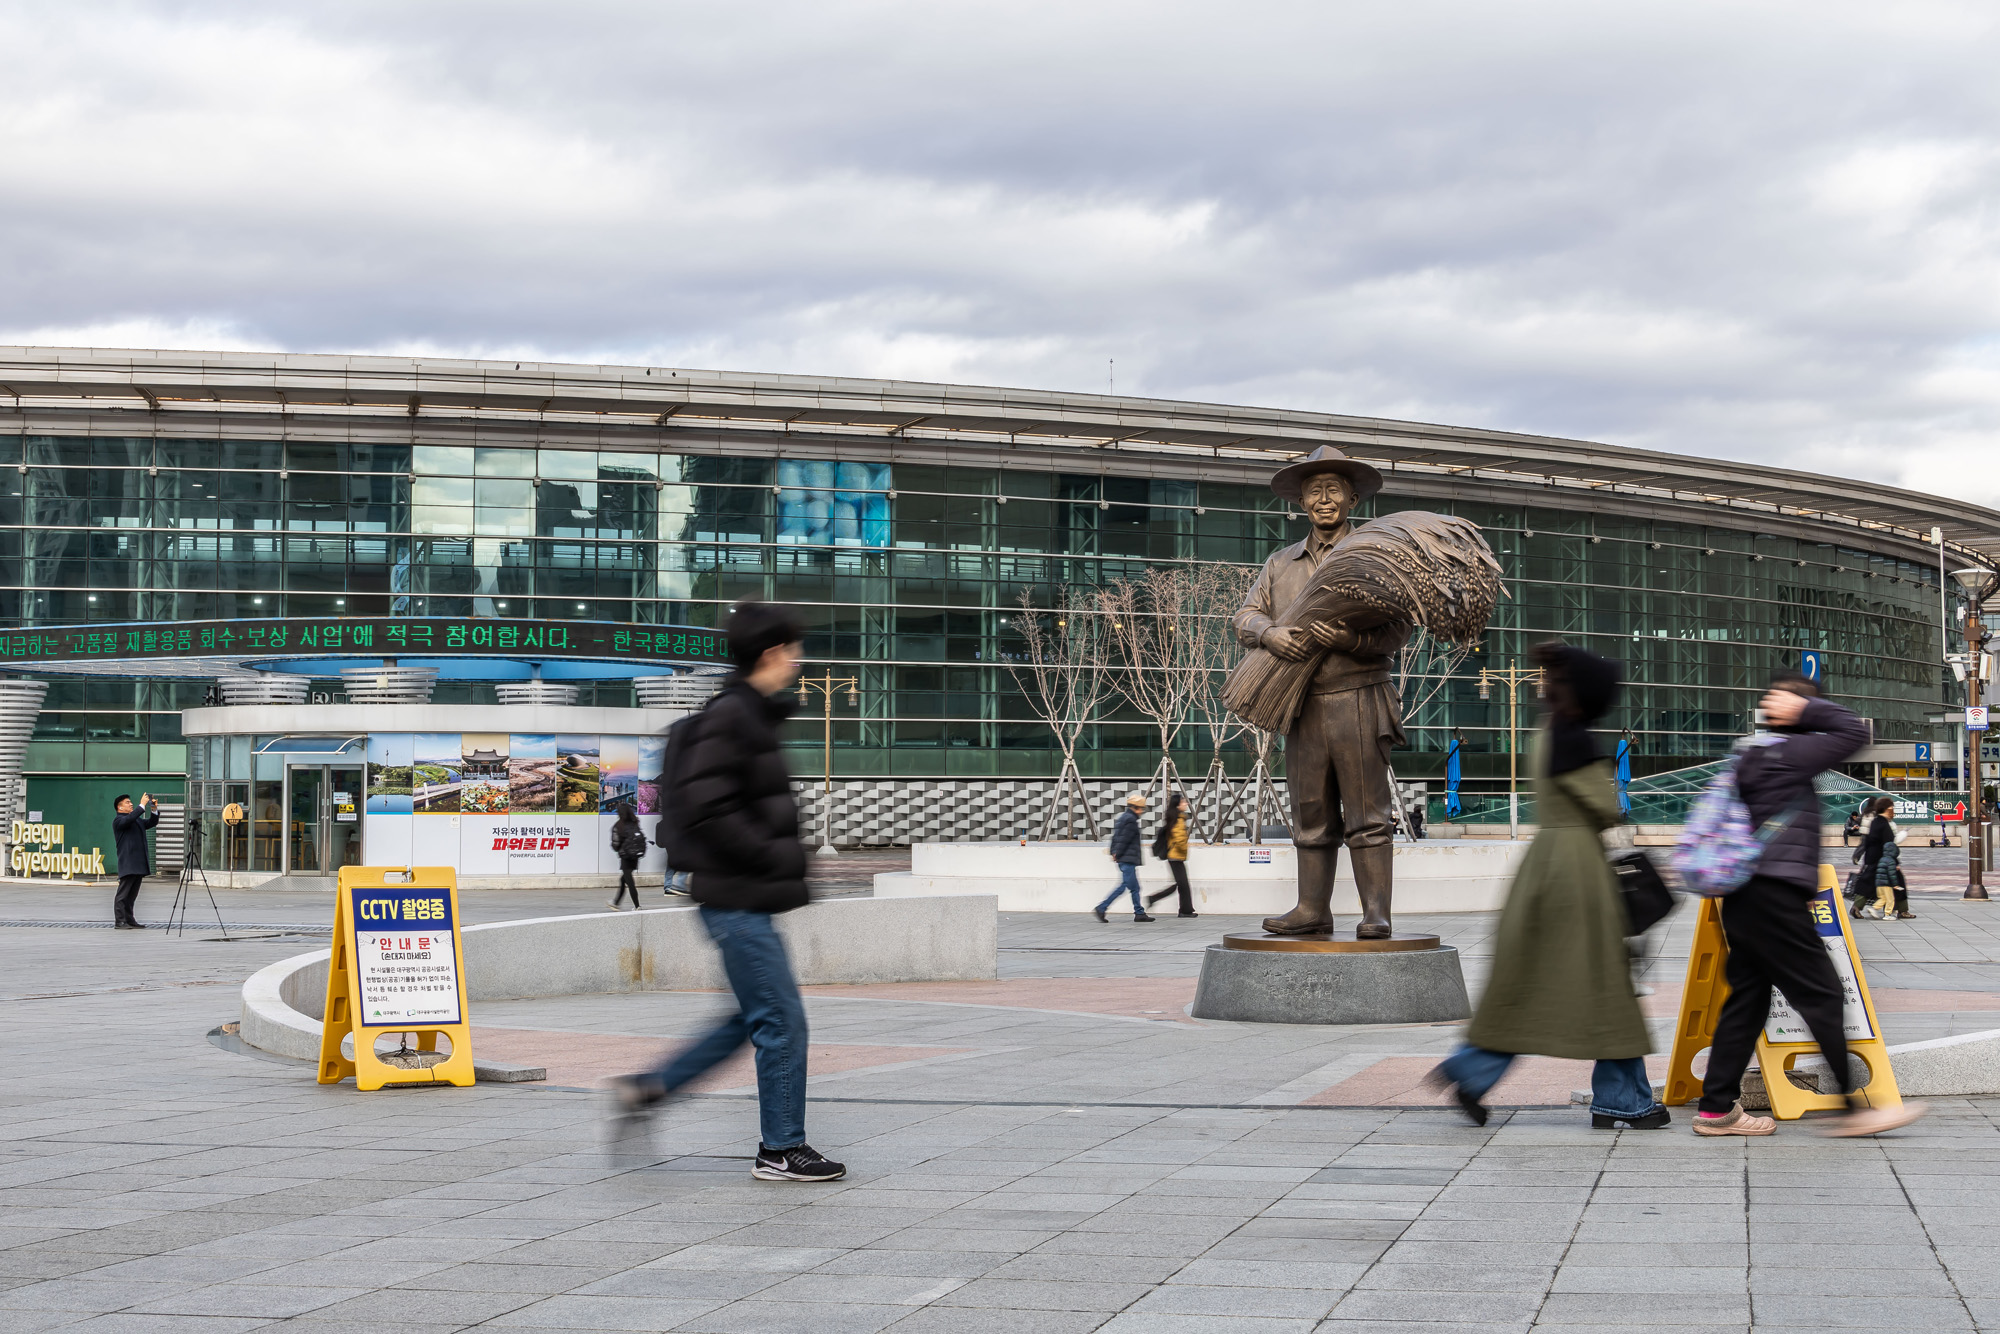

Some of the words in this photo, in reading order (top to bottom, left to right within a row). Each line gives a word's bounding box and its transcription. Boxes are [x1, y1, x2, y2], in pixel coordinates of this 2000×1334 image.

[0, 634, 58, 656] 지급하는
[66, 632, 118, 654] '고품질
[126, 630, 192, 652] 재활용품
[300, 625, 373, 648] 사업'에
[386, 625, 434, 647] 적극
[446, 625, 577, 648] 참여합시다.
[614, 630, 715, 657] 한국환경공단
[1806, 655, 1817, 680] 2
[1919, 745, 1928, 760] 2
[1934, 800, 1952, 810] 55m
[12, 820, 64, 850] Daegu
[492, 827, 518, 836] 자유와
[520, 826, 544, 836] 활력이
[546, 827, 571, 836] 넘치는
[492, 838, 538, 850] 파워풀
[540, 838, 570, 850] 대구
[12, 846, 105, 880] Gyeongbuk
[360, 898, 399, 920] CCTV
[402, 898, 445, 920] 촬영중
[381, 952, 406, 960] (손대지
[406, 952, 432, 960] 마세요)
